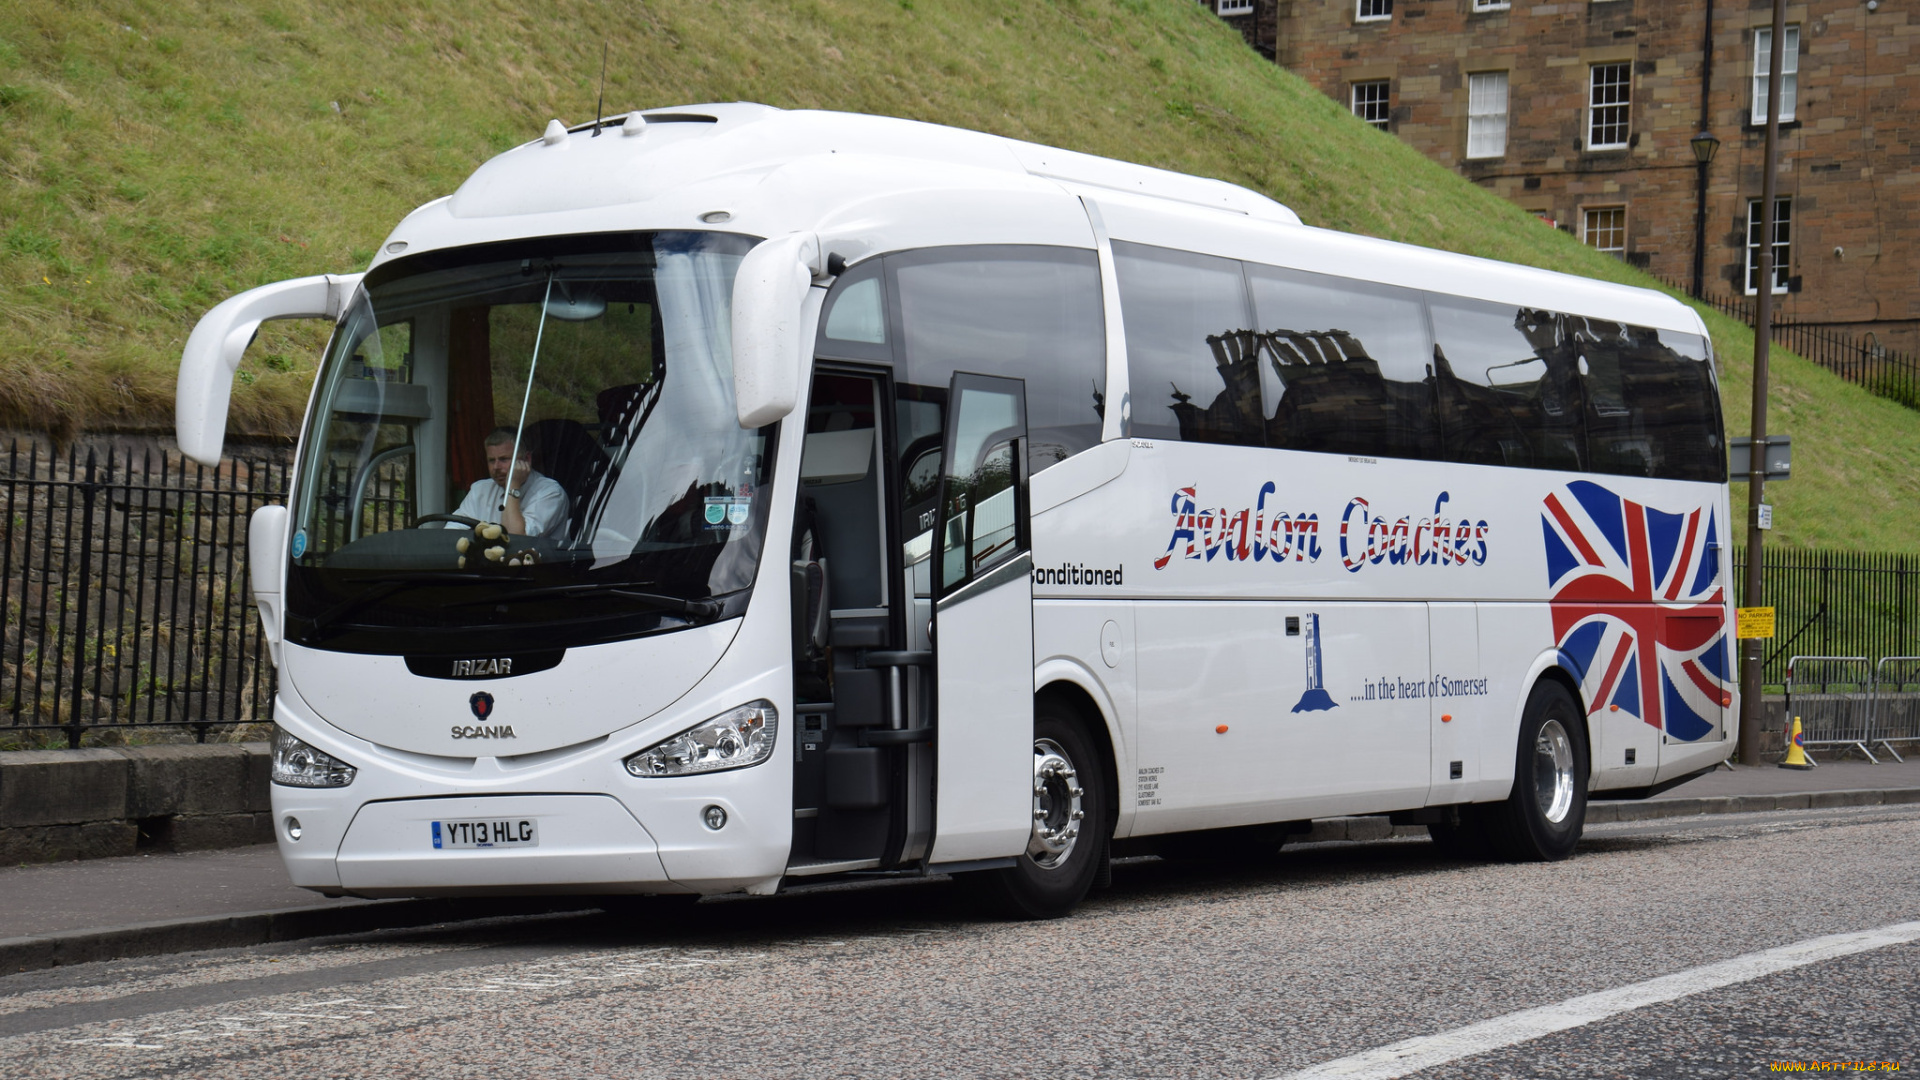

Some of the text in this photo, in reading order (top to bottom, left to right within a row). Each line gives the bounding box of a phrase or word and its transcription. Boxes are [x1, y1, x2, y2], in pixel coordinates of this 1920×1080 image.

[1154, 481, 1489, 573] Avalon Coaches
[452, 658, 512, 676] IRIZAR
[1378, 676, 1395, 700] the
[1398, 676, 1426, 699] heart
[1428, 674, 1440, 698] of
[1441, 676, 1488, 697] Somerset
[451, 725, 517, 739] SCANIA
[447, 820, 533, 844] YT13 HLG
